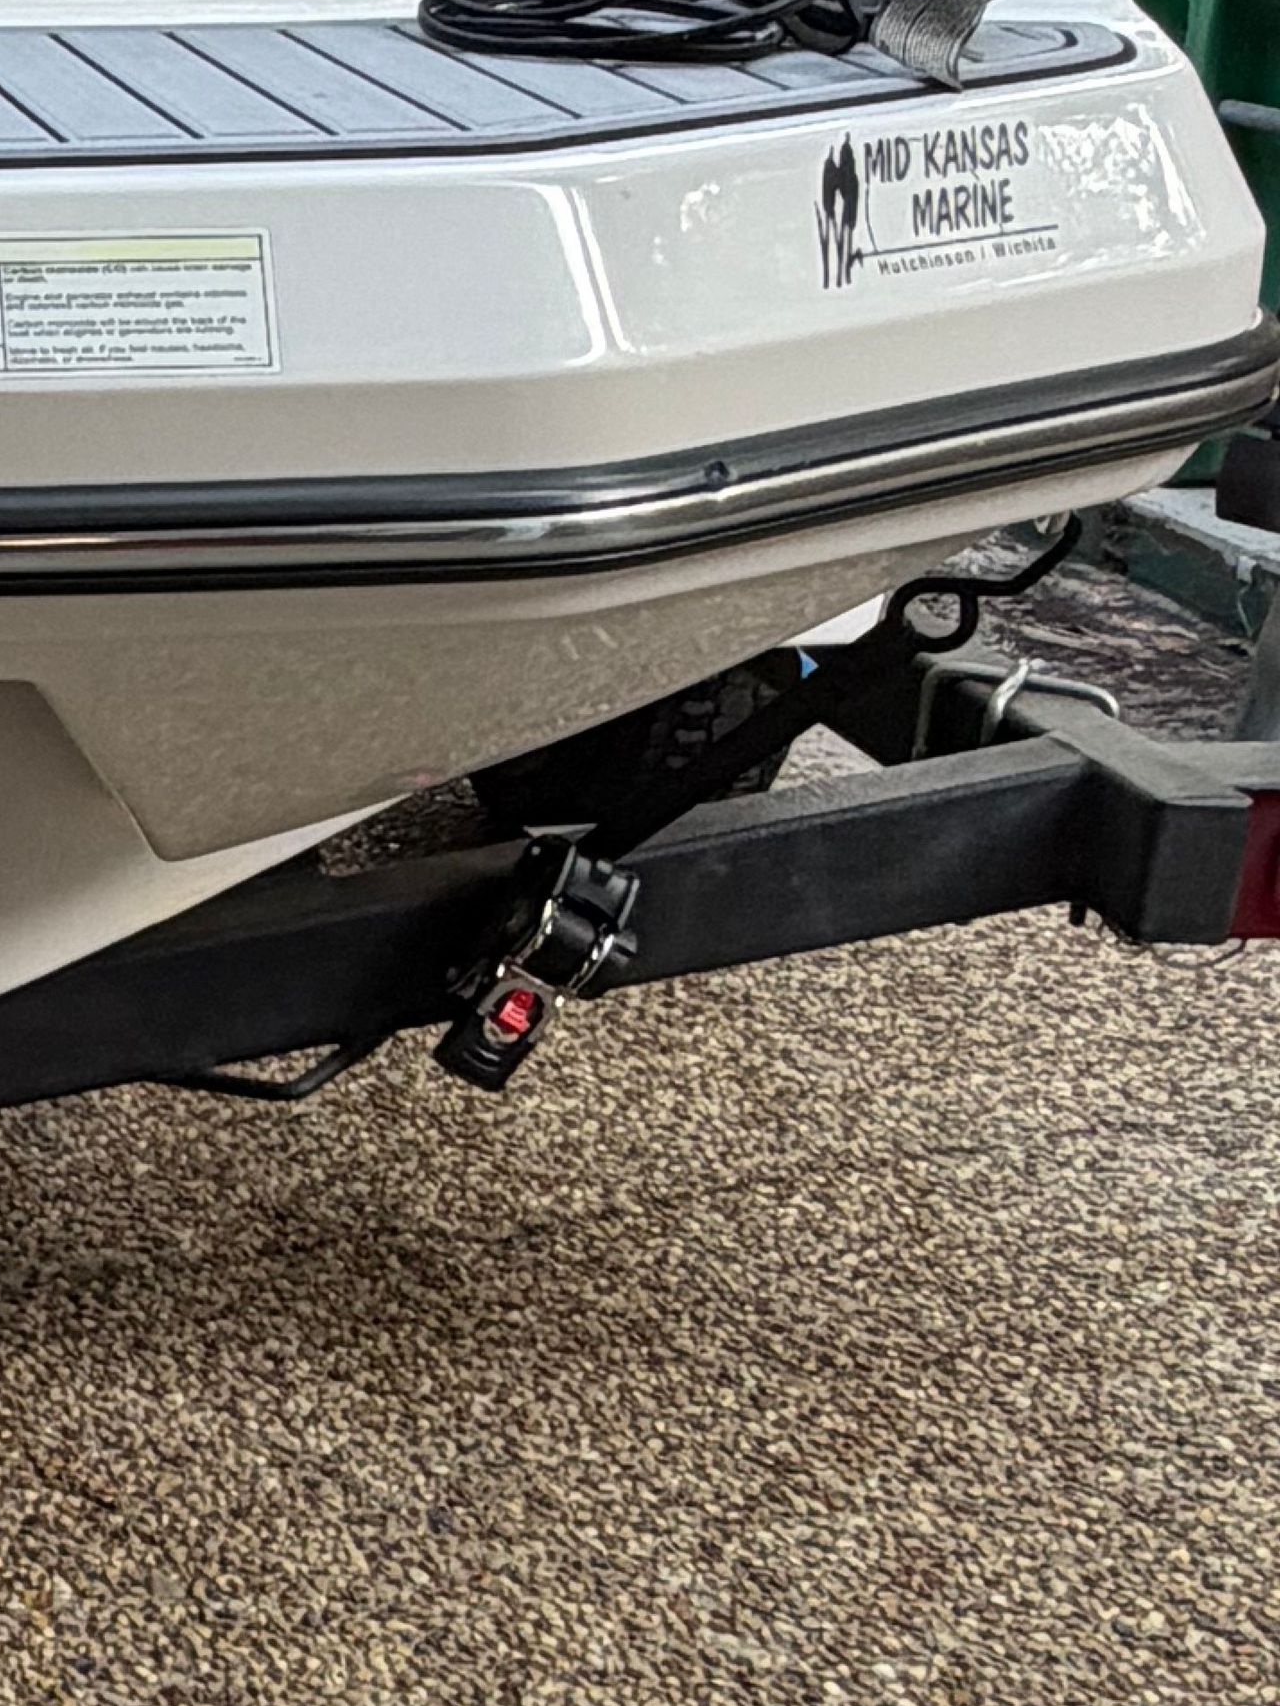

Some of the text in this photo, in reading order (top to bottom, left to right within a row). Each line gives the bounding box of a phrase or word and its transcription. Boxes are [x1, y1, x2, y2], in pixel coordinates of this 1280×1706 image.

[864, 121, 1029, 184] MID KANSAS
[913, 178, 1015, 237] MARINE
[878, 249, 975, 275] Hutchinson
[992, 237, 1056, 258] Wichita
